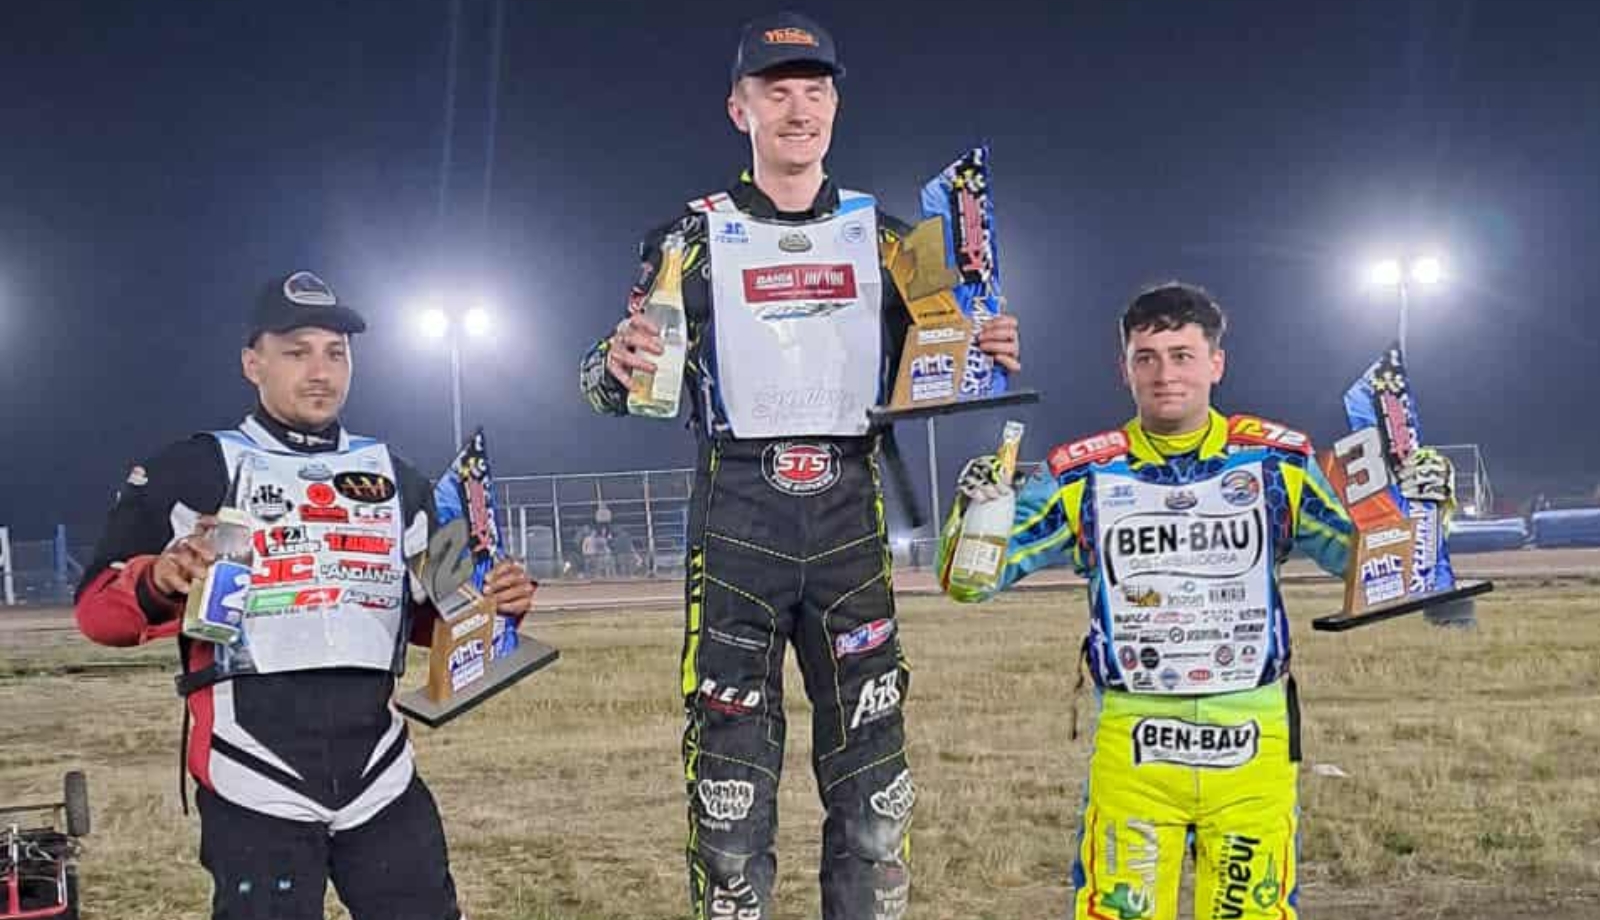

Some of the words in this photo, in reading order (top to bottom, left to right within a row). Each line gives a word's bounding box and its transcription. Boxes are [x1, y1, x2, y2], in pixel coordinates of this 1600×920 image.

[776, 453, 831, 473] STS
[1334, 426, 1389, 504] 3
[1117, 520, 1249, 556] BEN-BAU
[251, 556, 315, 585] JC
[429, 518, 475, 603] 2
[1143, 724, 1252, 751] BEN-BAU
